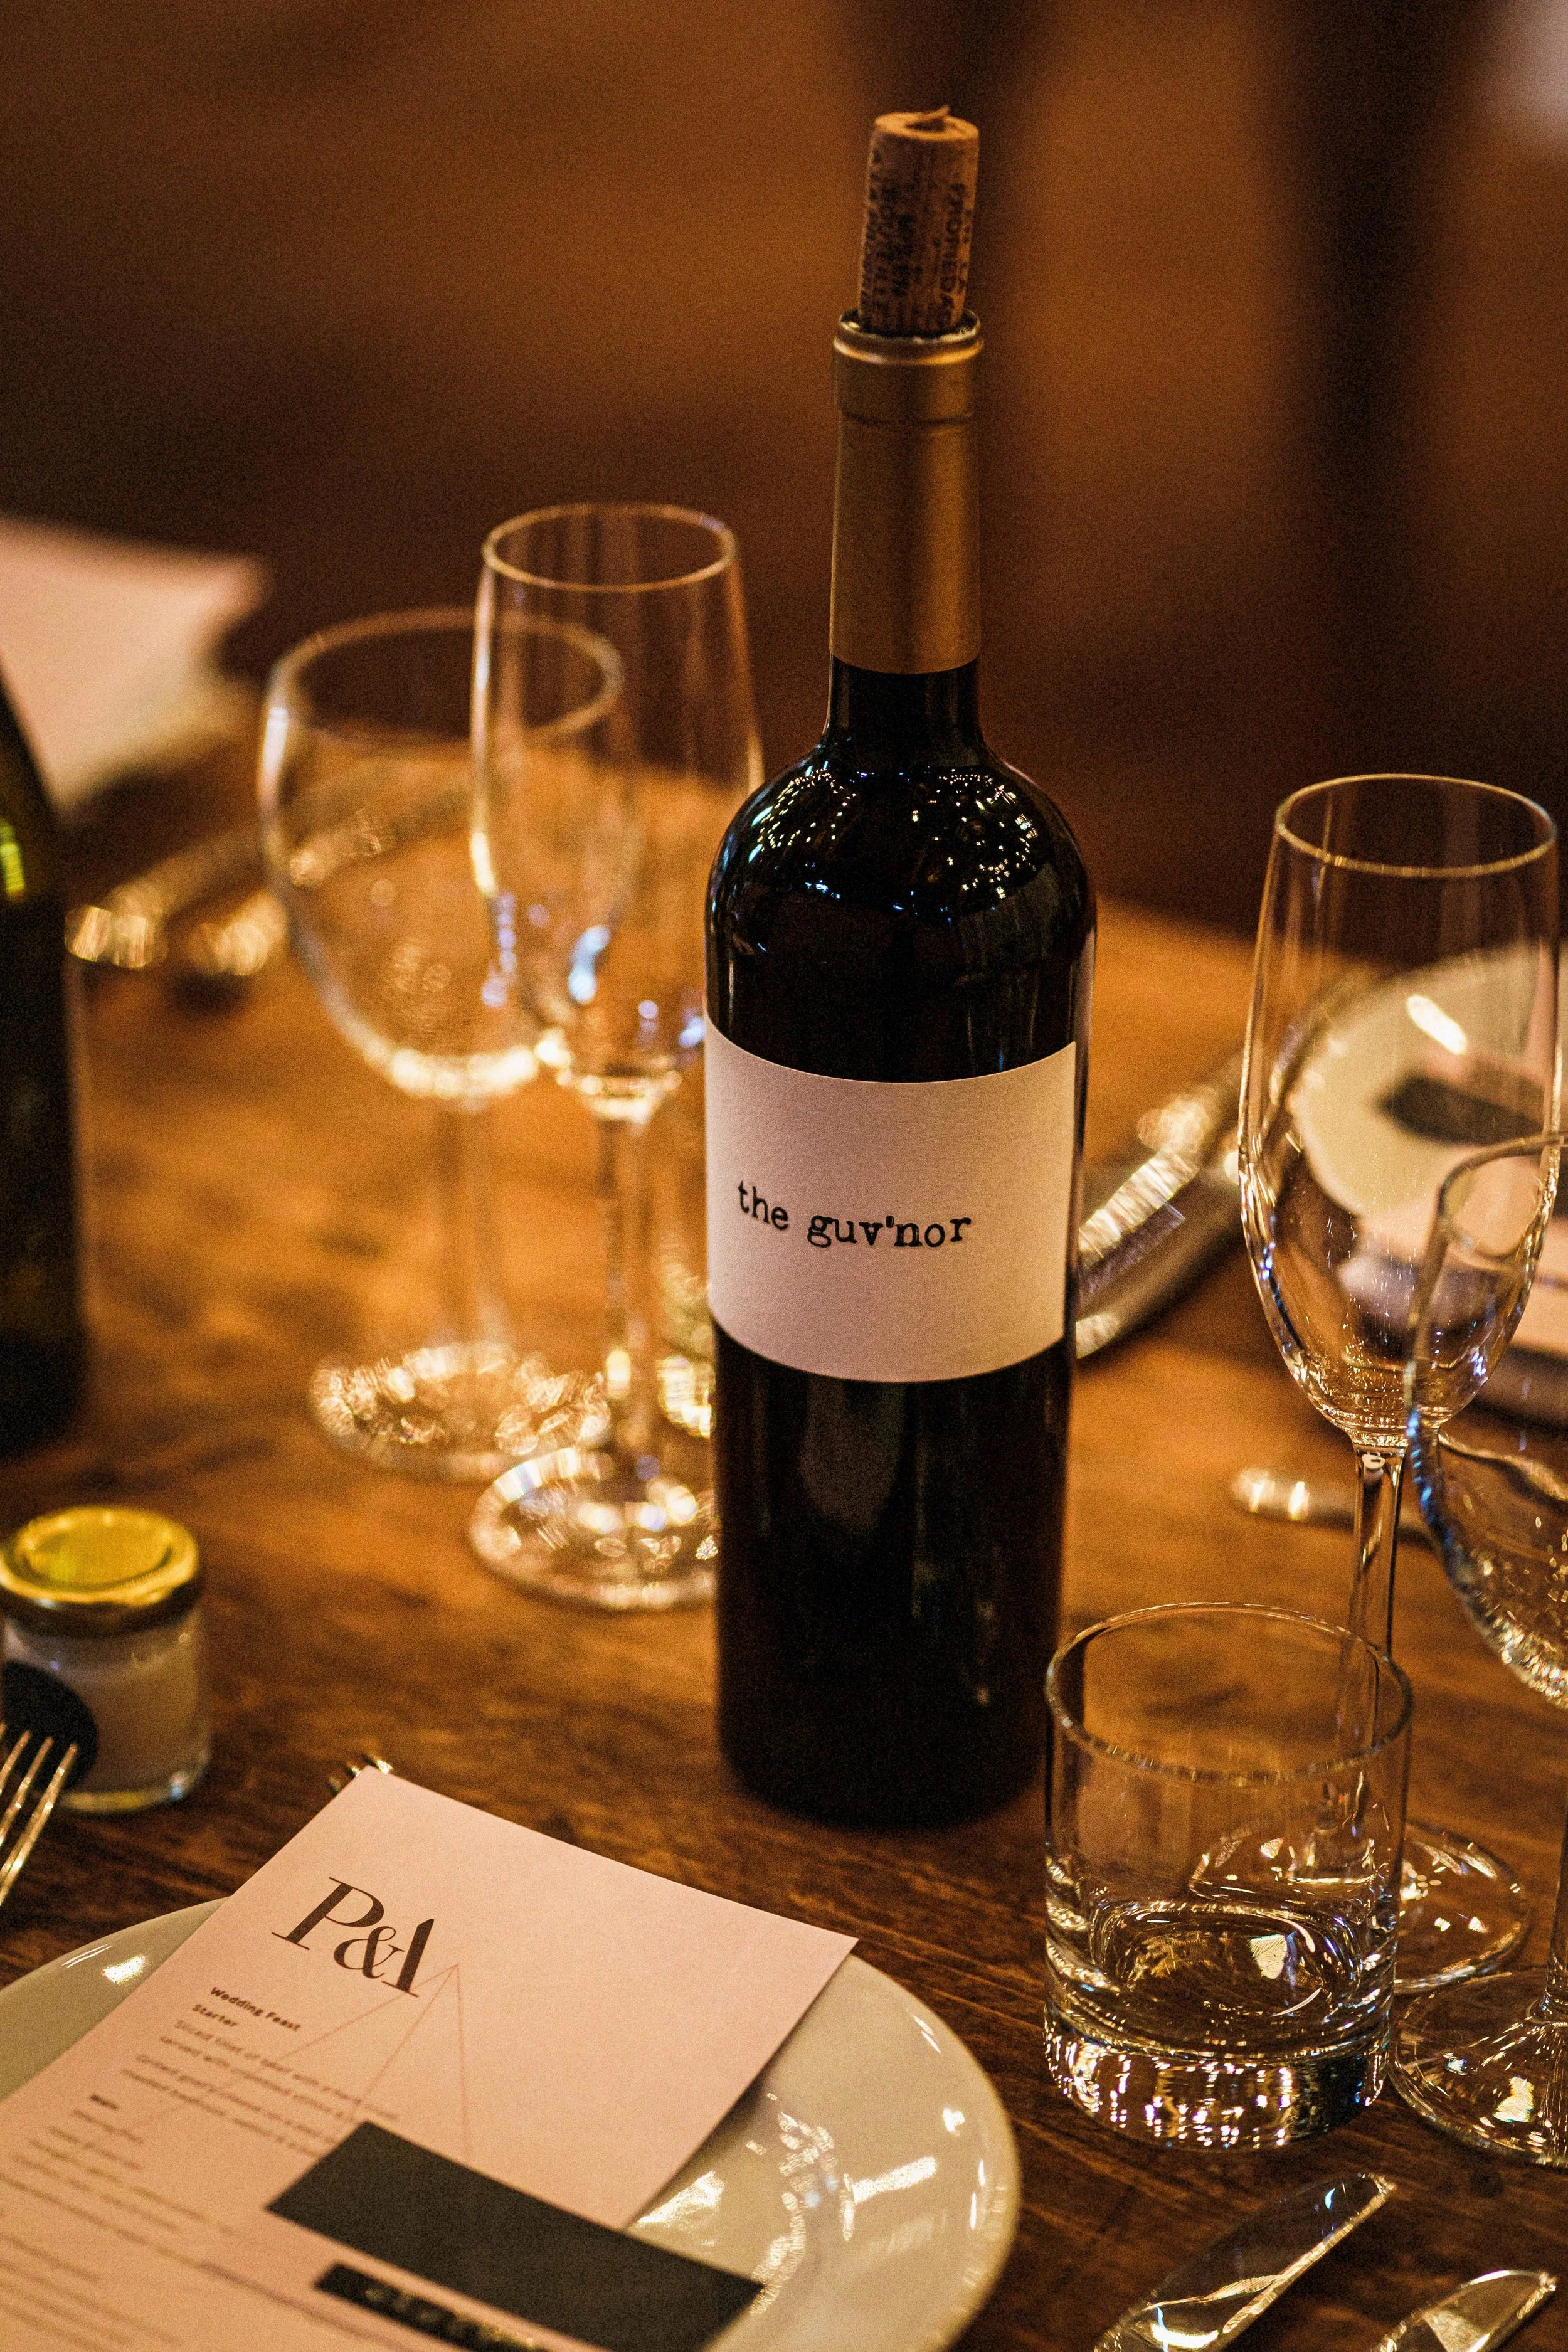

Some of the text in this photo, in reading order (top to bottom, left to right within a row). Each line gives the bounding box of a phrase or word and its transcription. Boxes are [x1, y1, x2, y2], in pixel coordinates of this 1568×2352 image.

[737, 1180, 972, 1248] the guv'nor
[191, 2004, 239, 2028] Starter
[211, 1986, 302, 2032] Wedding Feast
